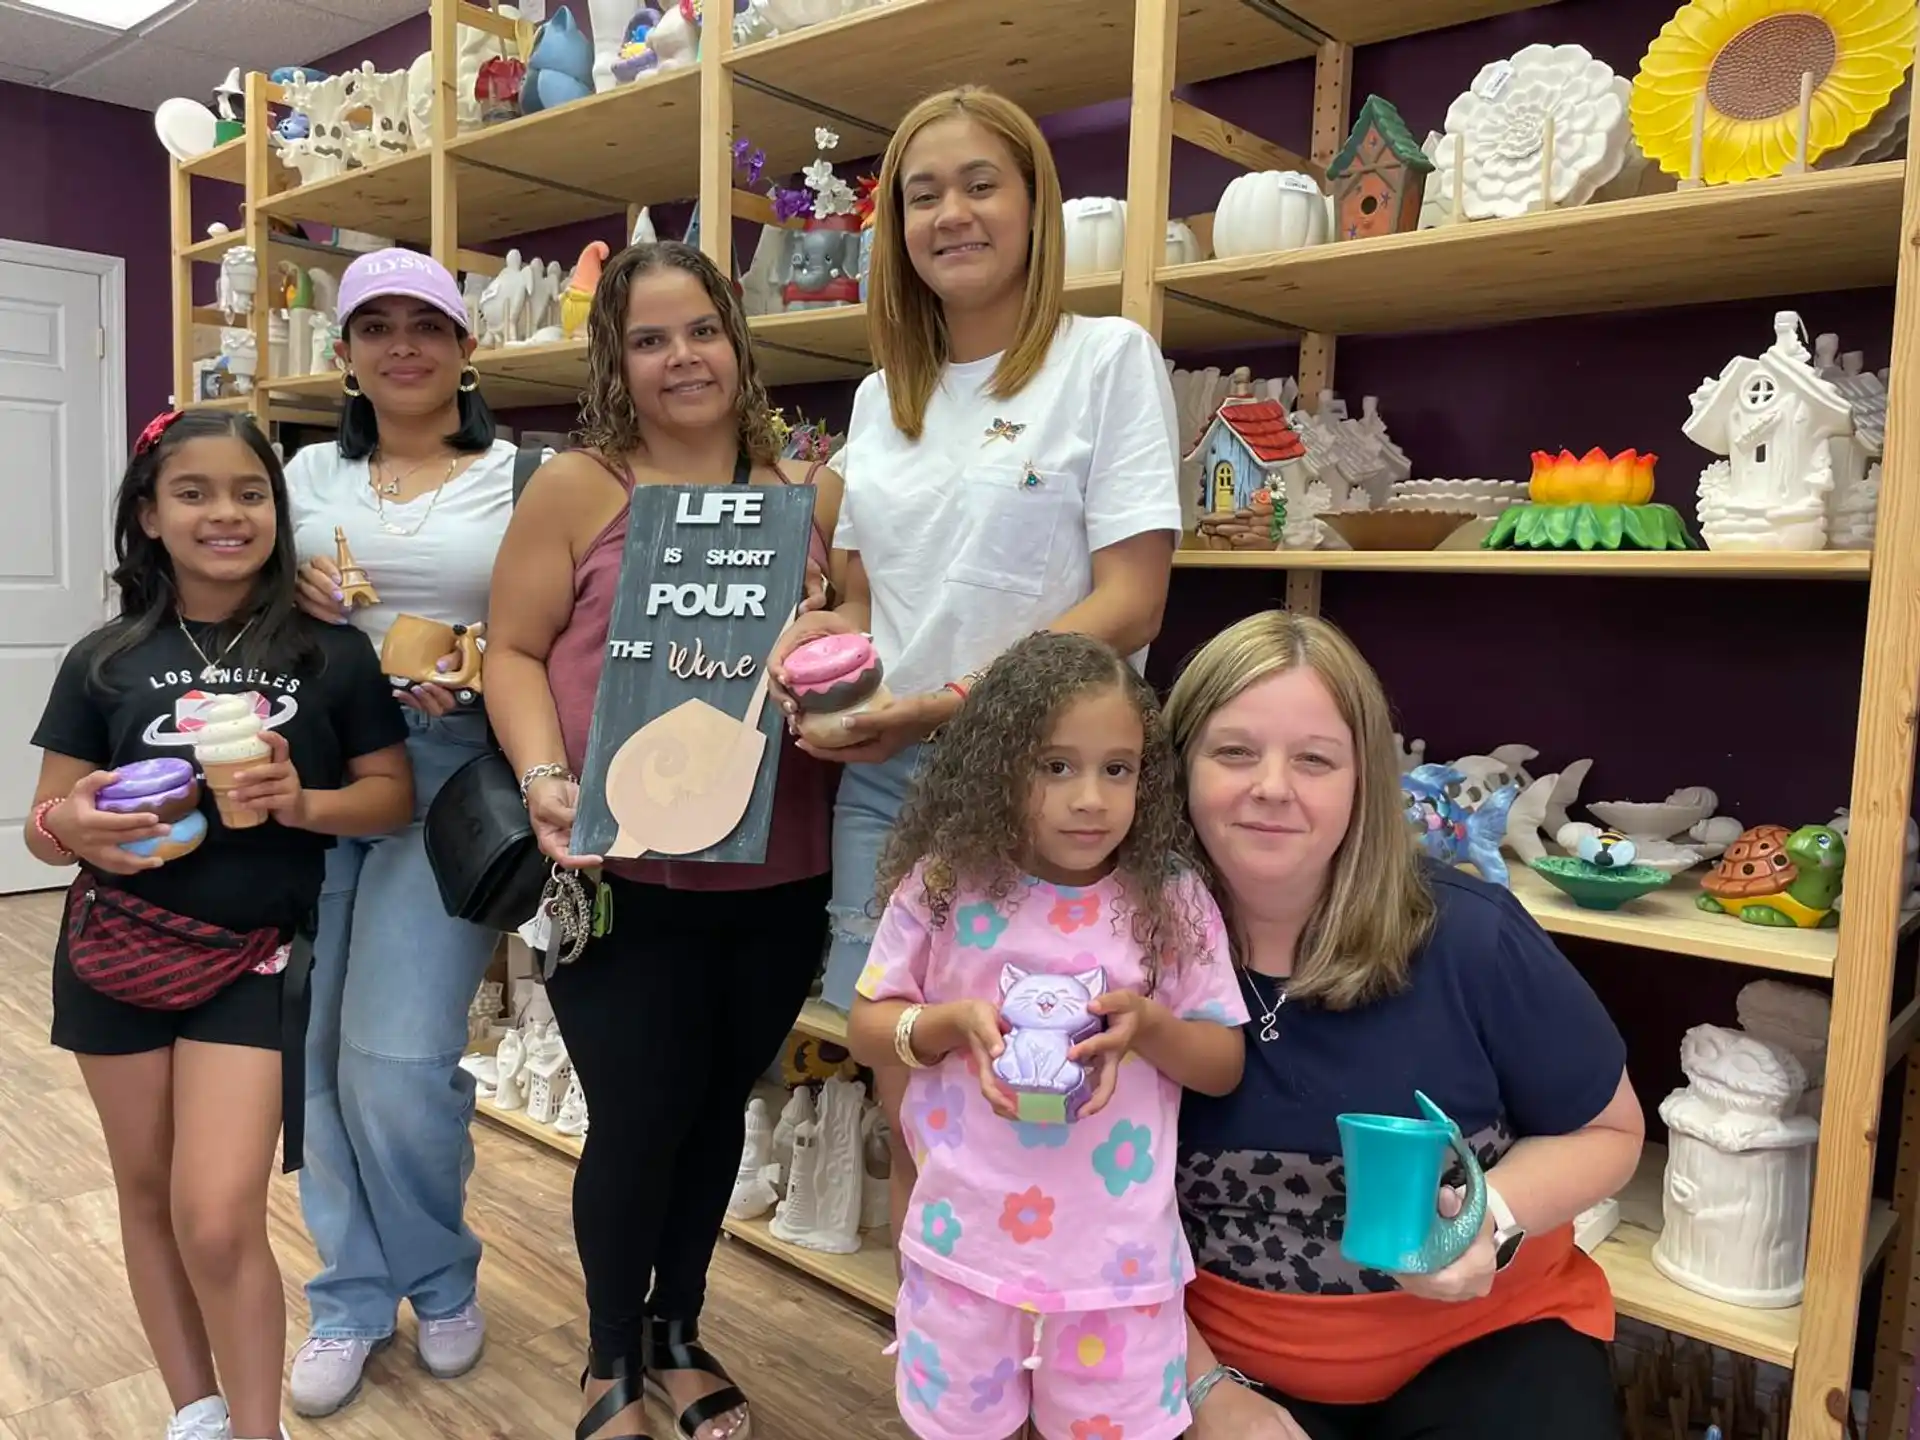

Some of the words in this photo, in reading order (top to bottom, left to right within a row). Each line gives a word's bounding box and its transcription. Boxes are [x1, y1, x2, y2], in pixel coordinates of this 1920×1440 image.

[364, 257, 434, 277] ILYSM
[676, 493, 764, 524] LIFE
[663, 547, 683, 564] IS
[706, 549, 776, 566] SHORT
[646, 583, 767, 617] POUR
[609, 640, 653, 659] THE
[668, 637, 757, 680] Wine
[150, 669, 193, 689] LOS
[203, 667, 300, 693] NGELES
